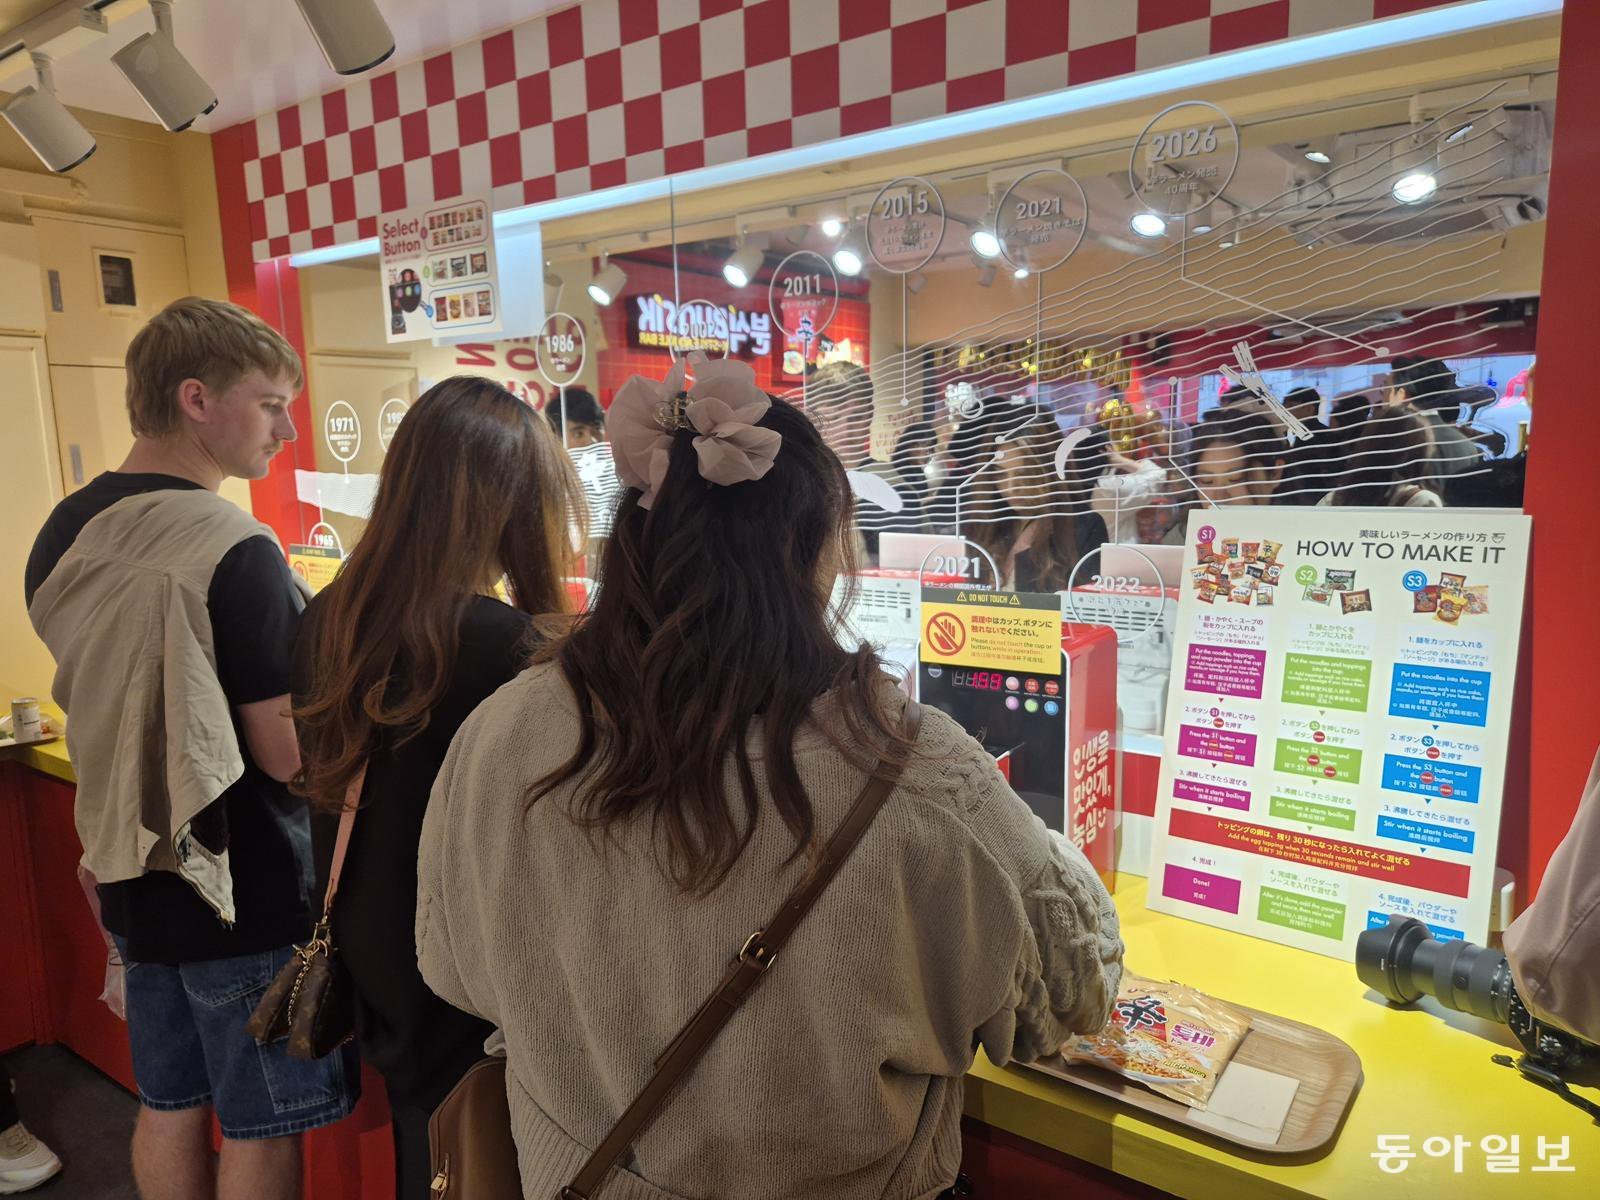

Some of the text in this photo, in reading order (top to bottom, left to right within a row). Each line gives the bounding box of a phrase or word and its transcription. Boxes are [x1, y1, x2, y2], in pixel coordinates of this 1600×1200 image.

[1152, 124, 1218, 163] 2026
[882, 192, 928, 221] 2015
[1016, 197, 1061, 220] 2021
[383, 218, 419, 239] Select
[384, 240, 420, 256] Button
[784, 274, 820, 297] 2011
[544, 334, 574, 353] 1986
[330, 417, 354, 432] 1971
[314, 535, 334, 547] 1965
[1201, 529, 1213, 540] S1
[1360, 530, 1488, 542] 美味しいラーメンの作り方
[1297, 539, 1506, 564] HOW TO MAKE IT
[933, 556, 980, 579] 2021
[1299, 570, 1314, 582] S2
[1091, 575, 1140, 593] 2022
[1405, 575, 1423, 588] S3
[990, 595, 1008, 603] TOUCH
[971, 625, 1039, 637] 触れないでください。
[1192, 706, 1209, 714] ボタン
[1399, 734, 1420, 744] ボタン
[1436, 740, 1480, 752] を押してから
[1073, 729, 1109, 780] 인생을
[1404, 747, 1426, 755] ボタン
[1441, 752, 1463, 760] を押す
[1396, 761, 1411, 769] Press
[1424, 763, 1432, 771] S3
[1434, 767, 1453, 775] button
[1455, 770, 1467, 778] and
[1434, 776, 1453, 785] button
[1226, 792, 1245, 802] boiling
[1287, 803, 1303, 811] when
[1310, 807, 1326, 816] starts
[1327, 810, 1349, 821] boiling
[1384, 820, 1395, 828] Stir
[1397, 823, 1415, 831] when
[1423, 828, 1441, 836] starts
[1443, 830, 1468, 843] boiling
[1228, 832, 1240, 840] Add
[1250, 838, 1262, 846] egg
[1262, 840, 1284, 850] topping
[1284, 844, 1300, 852] when
[1310, 850, 1334, 859] seconds
[1335, 854, 1356, 864] remain
[1382, 864, 1395, 872] well
[1192, 877, 1210, 888] Done!
[1370, 917, 1385, 925] After
[1115, 995, 1168, 1033] 辛
